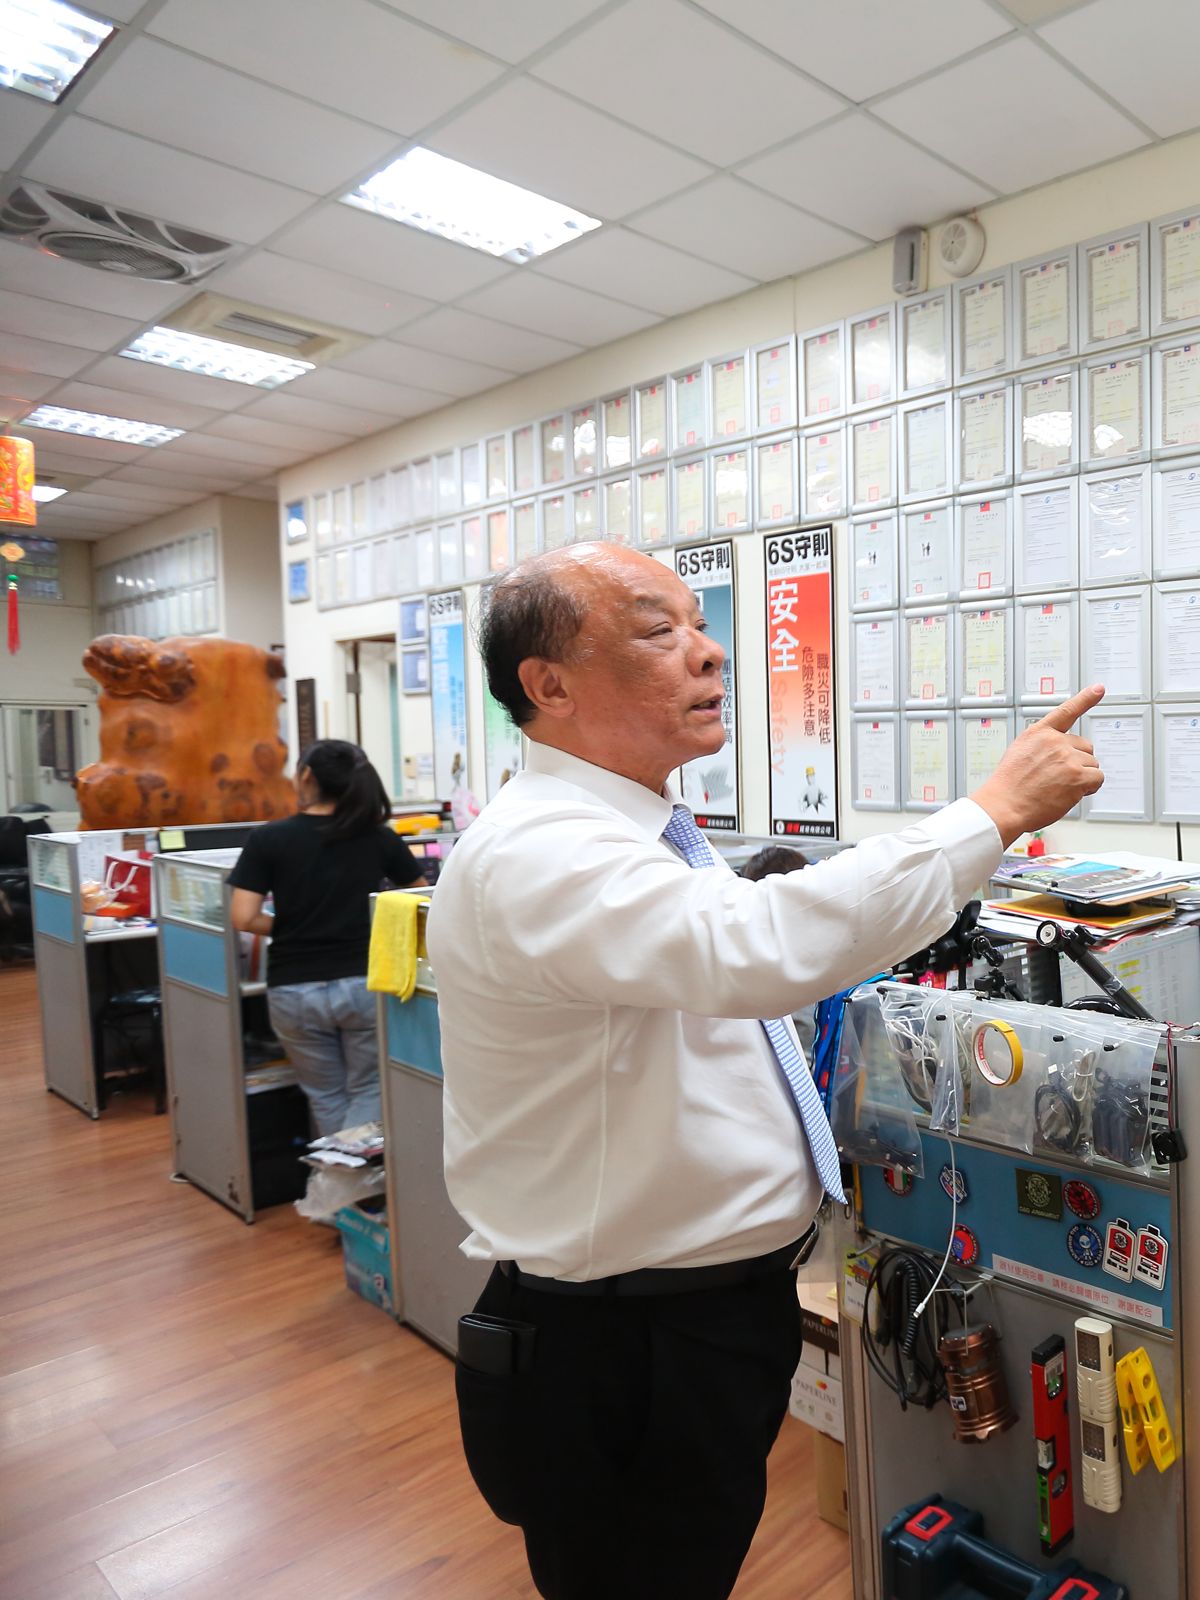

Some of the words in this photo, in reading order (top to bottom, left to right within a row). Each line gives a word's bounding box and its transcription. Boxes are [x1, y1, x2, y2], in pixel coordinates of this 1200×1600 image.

[679, 546, 730, 577] 6S守則
[768, 531, 829, 565] 6S守則
[770, 580, 799, 673] 安全
[771, 678, 788, 776] Safety
[802, 646, 816, 737] 危險多注意
[816, 653, 831, 745] 職災可降低
